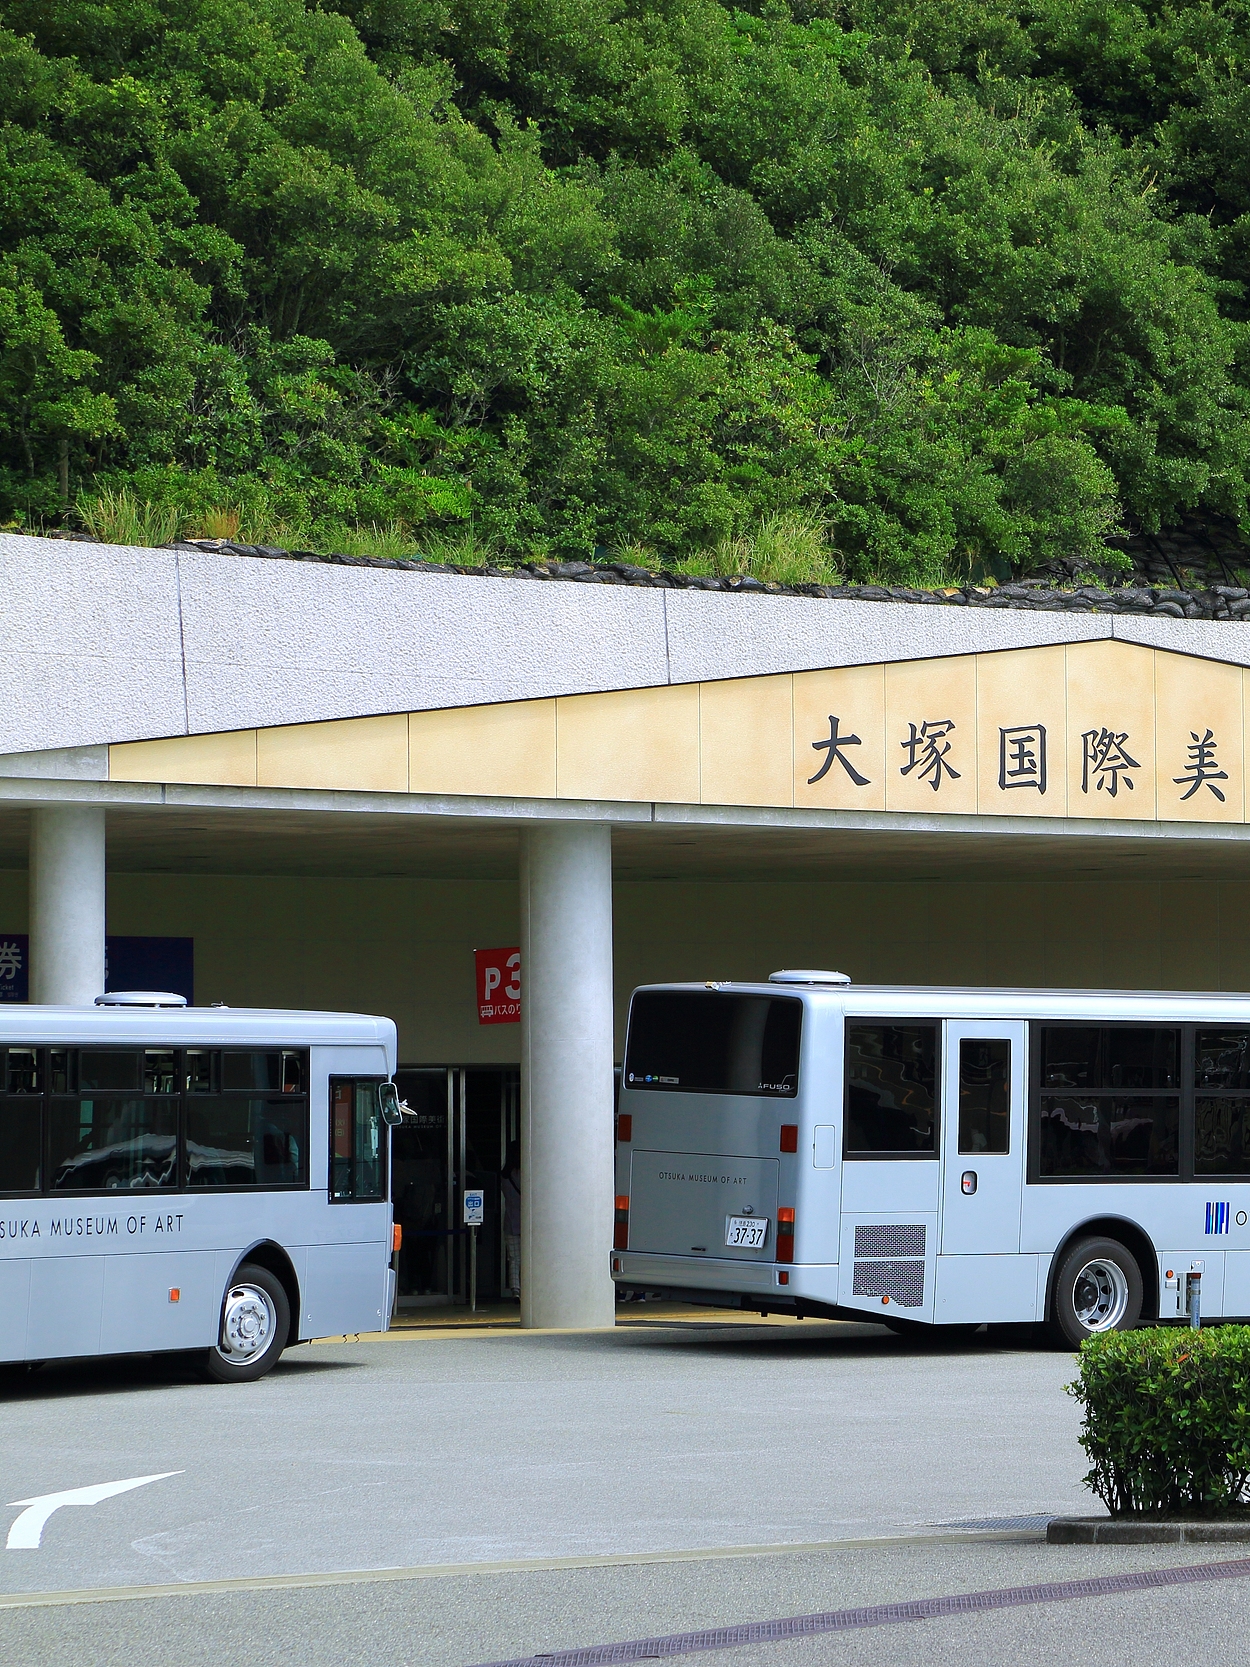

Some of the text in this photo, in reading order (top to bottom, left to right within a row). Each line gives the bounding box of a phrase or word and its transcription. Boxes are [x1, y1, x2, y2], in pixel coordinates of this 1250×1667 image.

[659, 1171, 686, 1180] OTSUKA
[689, 1174, 718, 1183] MUSEUM
[720, 1176, 730, 1184] OF
[50, 1217, 118, 1236] MUSEUM
[126, 1215, 146, 1234] OF
[154, 1214, 184, 1233] ART
